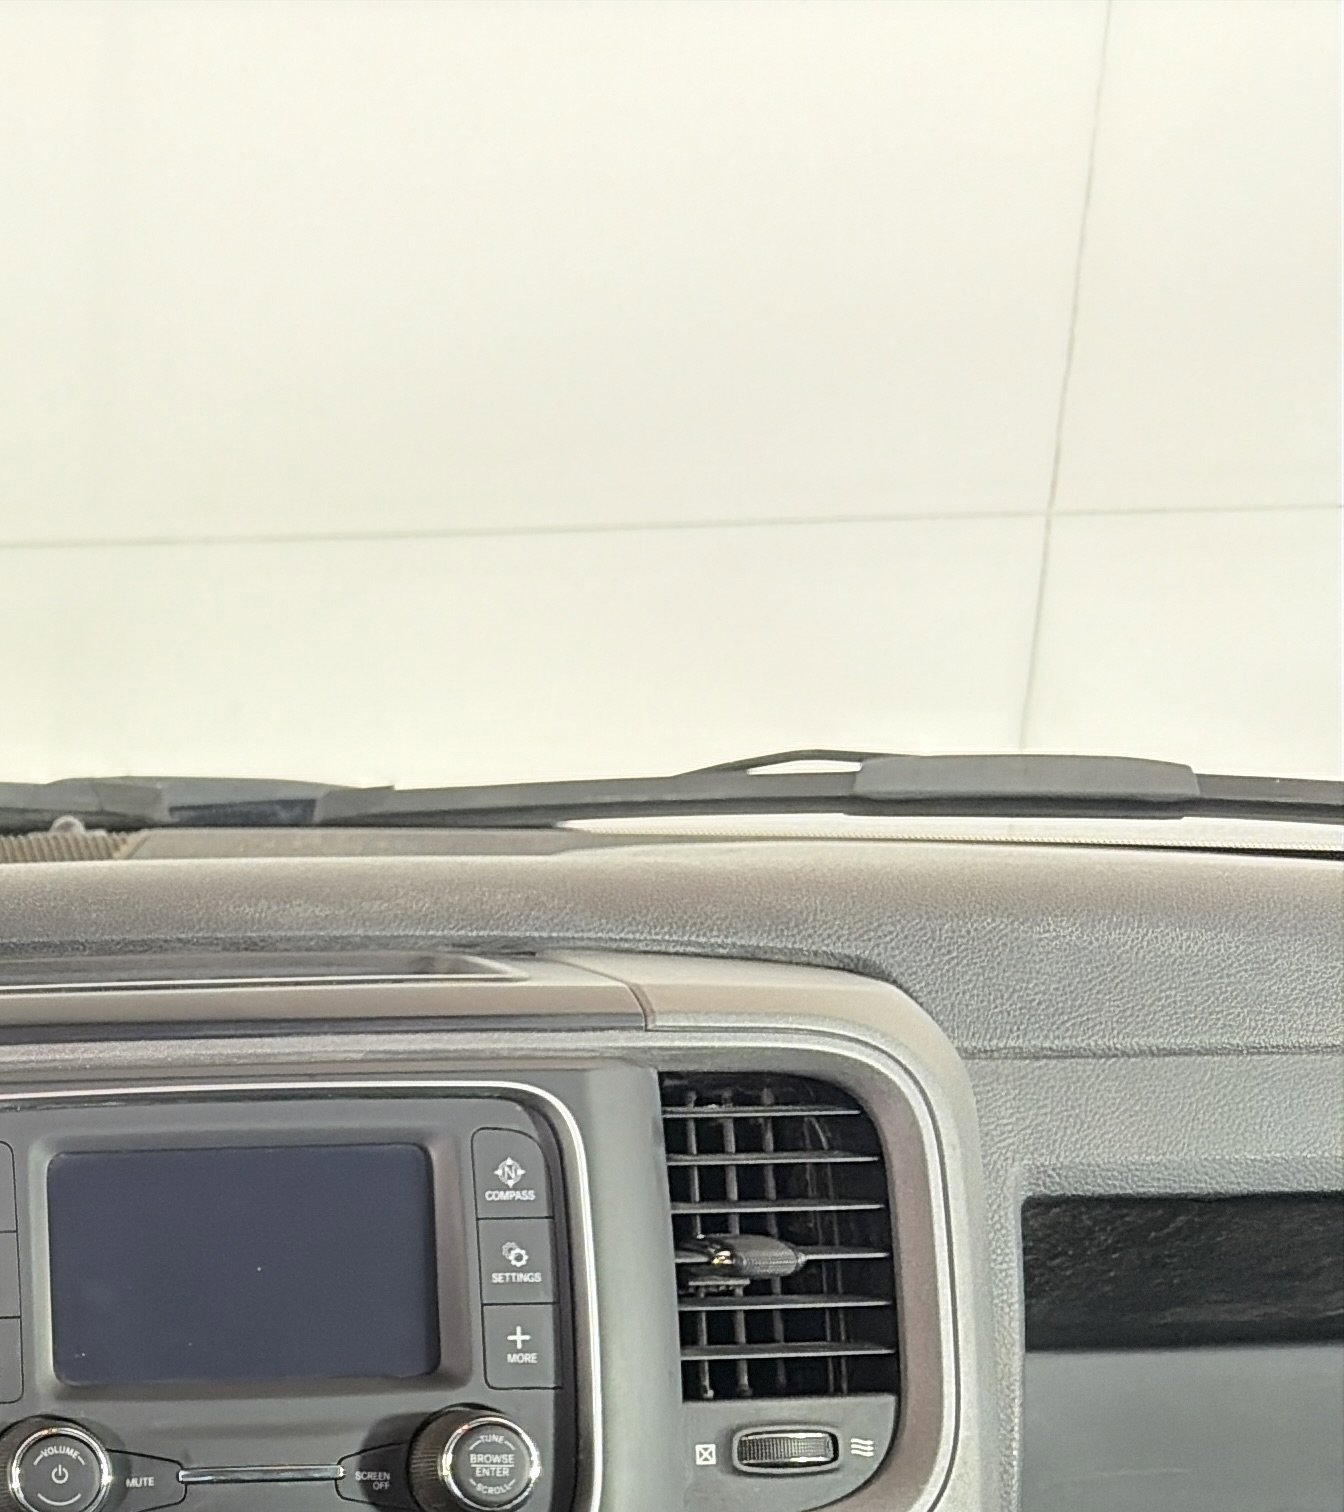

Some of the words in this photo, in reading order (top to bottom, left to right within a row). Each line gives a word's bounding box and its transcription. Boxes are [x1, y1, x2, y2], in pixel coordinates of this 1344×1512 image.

[484, 1189, 536, 1201] COMPASS
[491, 1271, 543, 1284] SETTINGS
[506, 1352, 539, 1364] MORE
[479, 1433, 505, 1444] TUNE
[40, 1445, 81, 1460] VOLUME
[469, 1453, 515, 1464] BROWSE
[475, 1466, 510, 1477] ENTER
[125, 1476, 156, 1488] MUTE
[372, 1481, 391, 1490] OFF
